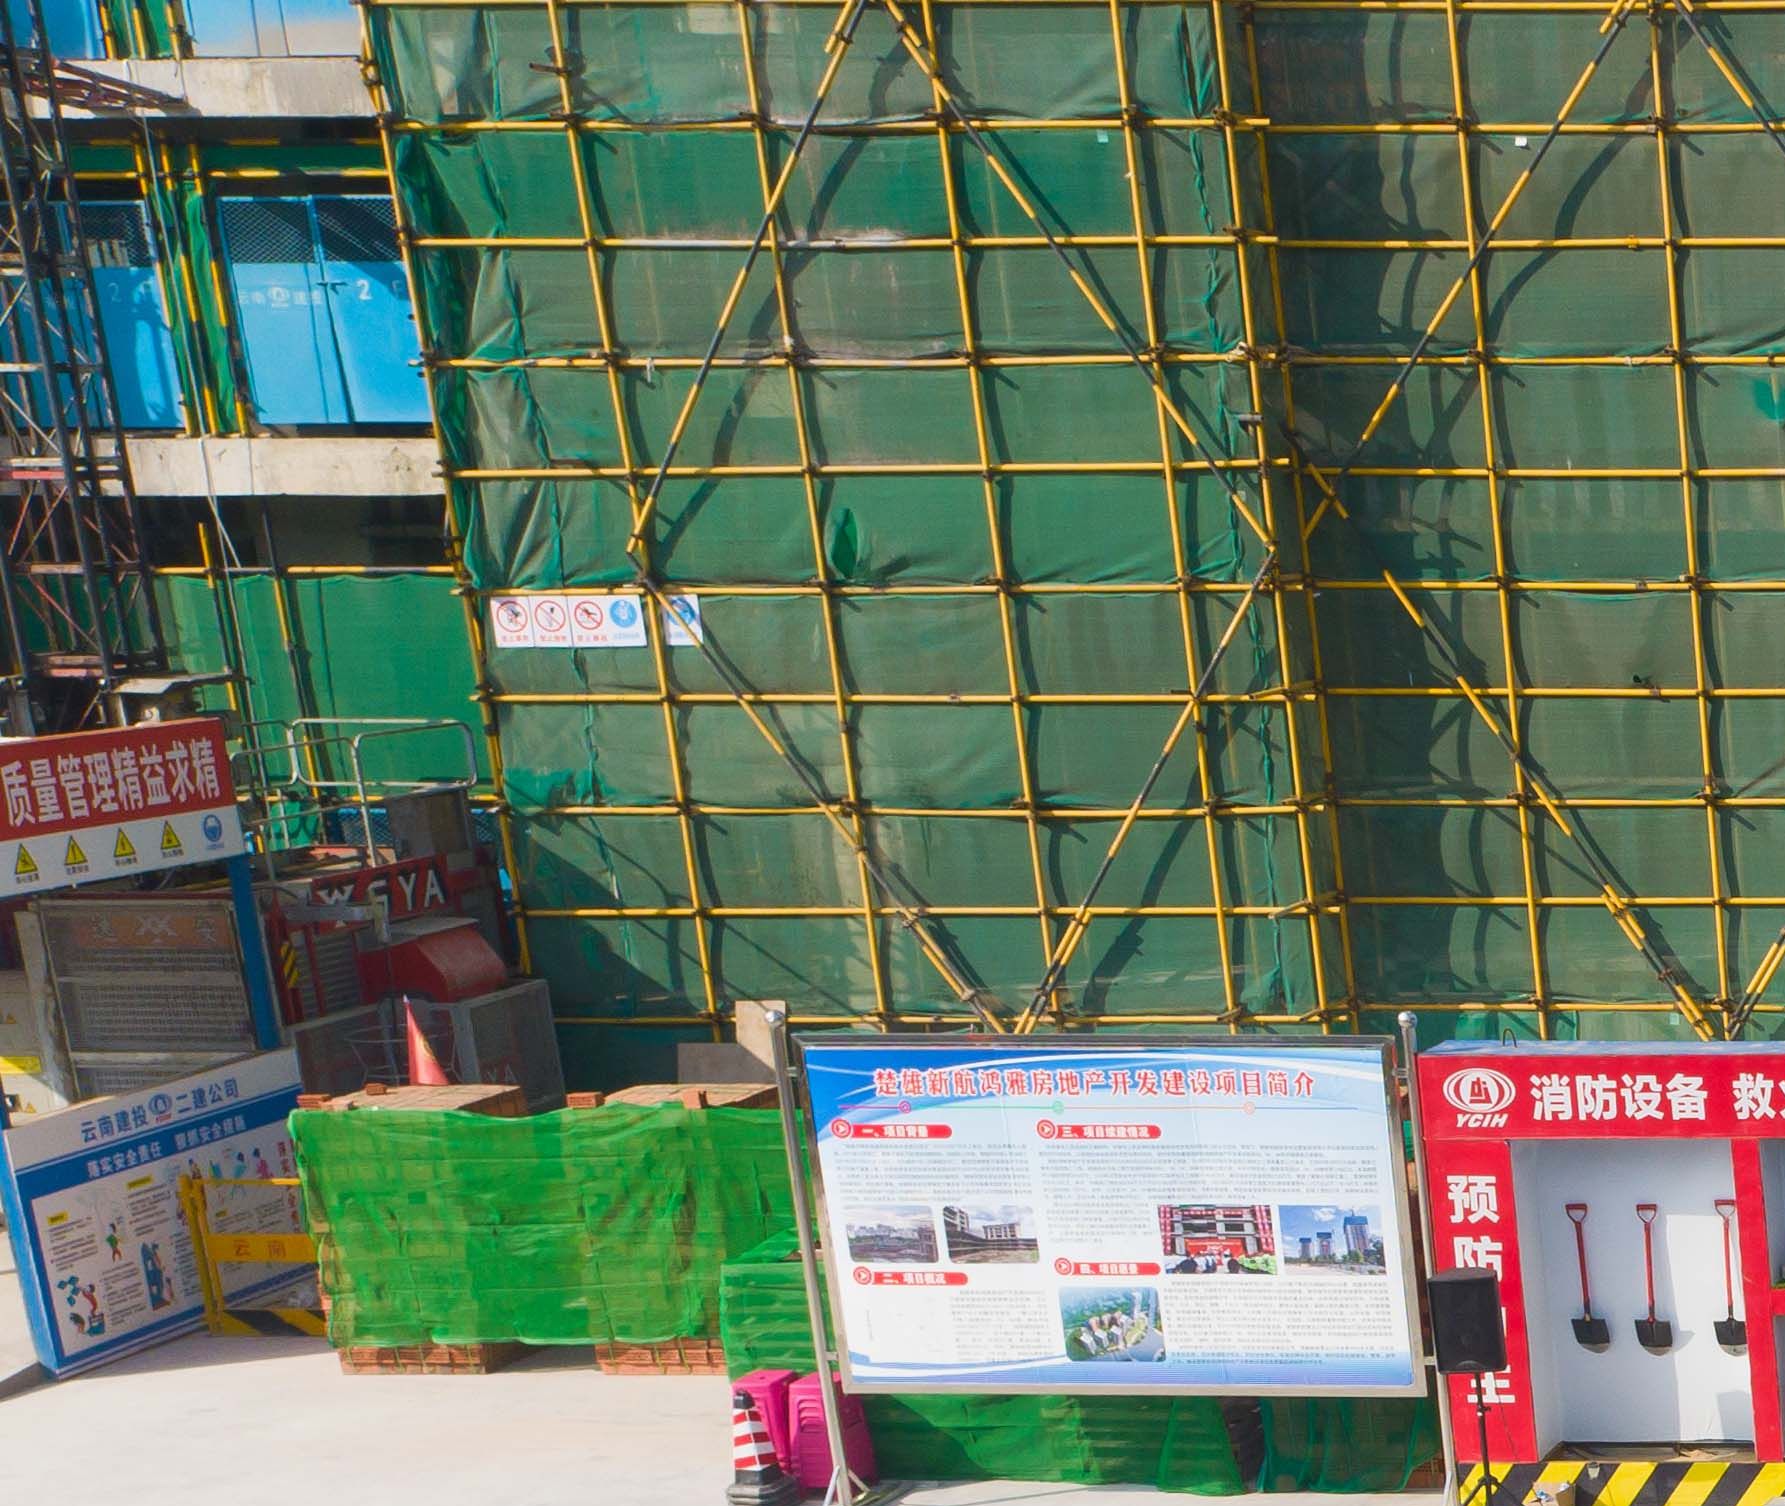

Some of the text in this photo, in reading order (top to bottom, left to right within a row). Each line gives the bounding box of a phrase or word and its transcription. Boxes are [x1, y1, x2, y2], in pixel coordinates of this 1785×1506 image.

[1, 739, 221, 828] 质量管理精益求精
[81, 1104, 149, 1143] 云南建投
[176, 1077, 239, 1114] 二建公司
[873, 1068, 1315, 1098] 楚雄新航鸿雅房地产开发建设项目简介
[1530, 1073, 1708, 1122] 消防设备
[1456, 1114, 1508, 1128] YCIH
[1447, 1175, 1516, 1404] 预防主
